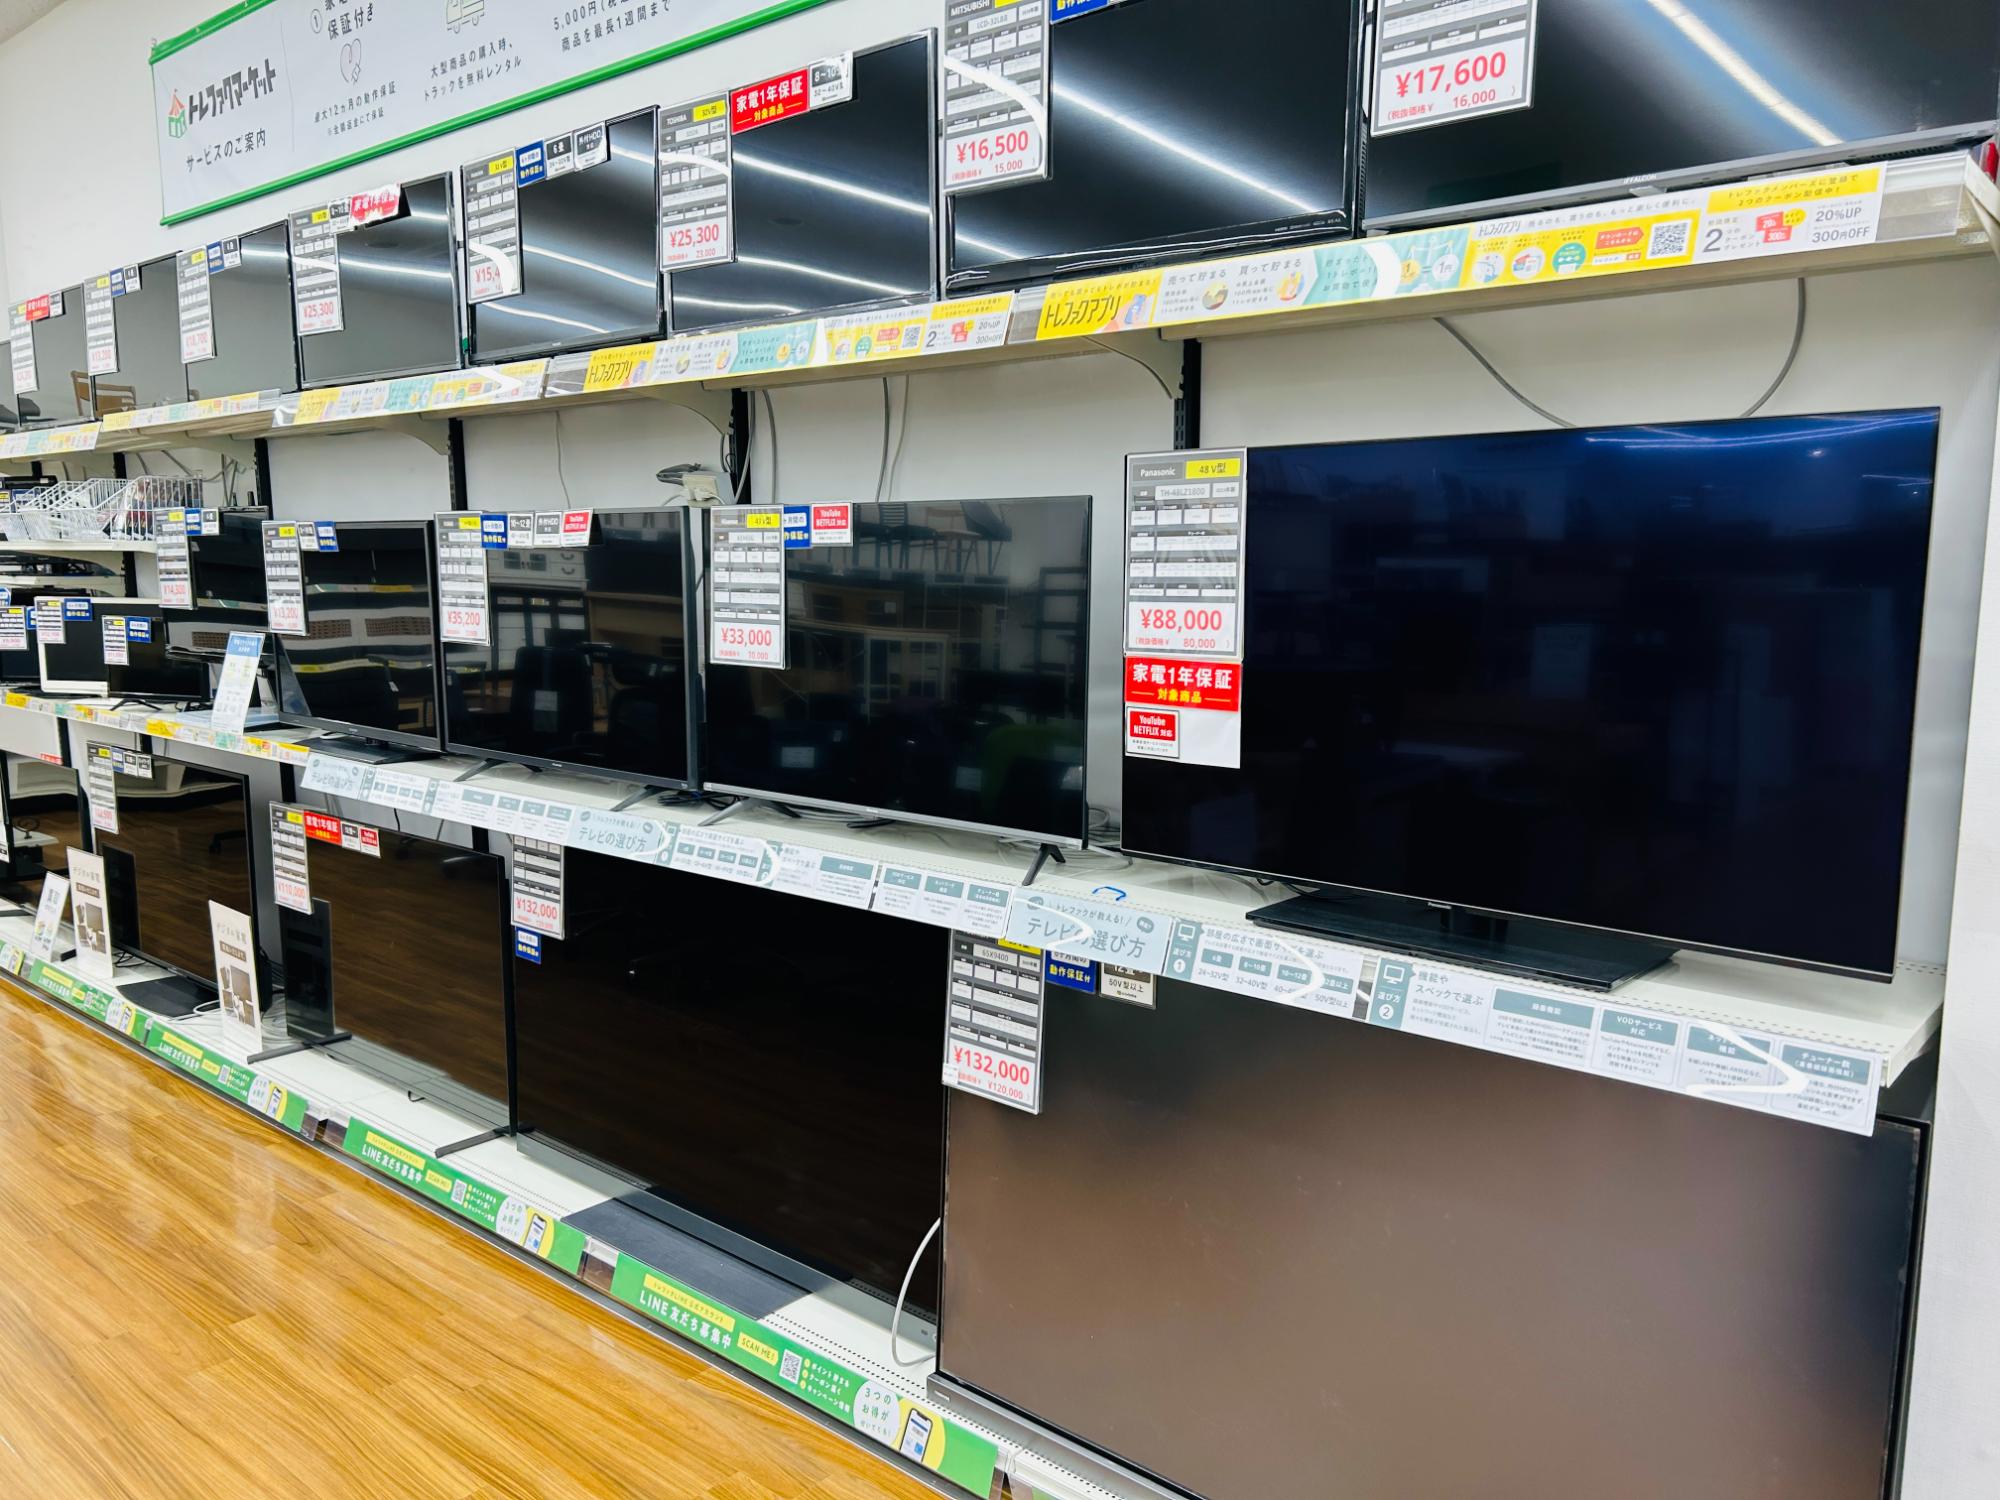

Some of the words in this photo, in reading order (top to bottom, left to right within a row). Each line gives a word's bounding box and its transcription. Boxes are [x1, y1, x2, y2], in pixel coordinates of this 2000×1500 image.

[951, 0, 990, 16] MITSUBISHI
[327, 3, 373, 40] 保証付き
[562, 0, 669, 52] 商品を最長1週間まで
[431, 37, 512, 78] 大型商品の購入時、
[424, 55, 521, 101] トラックを無料レンタル
[1396, 51, 1506, 97] ¥17,600
[189, 59, 276, 124] トレファクマーケット
[736, 76, 803, 112] 家電1年保証
[1453, 89, 1496, 108] 16,000
[754, 103, 783, 121] 対象商品
[186, 129, 266, 172] サービスのご案内
[957, 130, 1029, 163] ¥16,500
[995, 159, 1022, 173] 15,000
[1815, 207, 1861, 222] 20%UP
[670, 224, 719, 248] ¥25,300
[1703, 228, 1723, 252] 2
[1812, 226, 1870, 243] 300円OFF
[1168, 269, 1226, 286] 売って貯まる
[1239, 258, 1301, 276] 買って貯まる
[304, 302, 334, 318] ¥25,300
[1045, 295, 1121, 328] トレファクアプリ
[1140, 467, 1175, 477] Panasonic
[448, 610, 480, 626] ¥35,200
[1141, 608, 1222, 632] ¥88,000
[721, 628, 772, 647] ¥33,000
[1184, 638, 1215, 648] 80,000
[1133, 664, 1232, 689] 家電1年保証
[1158, 689, 1201, 703] 対象商品
[1140, 715, 1166, 726] YouTube
[1133, 725, 1159, 737] NETFLIX
[579, 828, 647, 852] テレビの選び方
[516, 897, 557, 919] ¥132,000
[1049, 964, 1090, 983] 動作保証付
[1419, 971, 1448, 984] 機能や
[1109, 978, 1144, 992] 50V型以上
[1377, 991, 1401, 1003] 選び方
[1416, 984, 1484, 1006] スペックで選ぶ
[1383, 1007, 1390, 1017] 2
[1532, 1003, 1561, 1015] 録画機能
[1617, 1015, 1662, 1031] VODサービス
[1630, 1027, 1646, 1037] 対応
[1719, 1045, 1735, 1055] 機能
[954, 1045, 1029, 1085] ¥132,000
[1802, 1052, 1850, 1068] チューナー数
[987, 1082, 1023, 1099] ¥120,000
[361, 1144, 382, 1163] LINE
[381, 1153, 423, 1184] 友だち募集中
[639, 1290, 669, 1315] LINE
[670, 1306, 731, 1349] 友だち募集中
[741, 1337, 759, 1353] SCAN
[864, 1387, 892, 1405] 3つの
[862, 1403, 889, 1423] お得が
